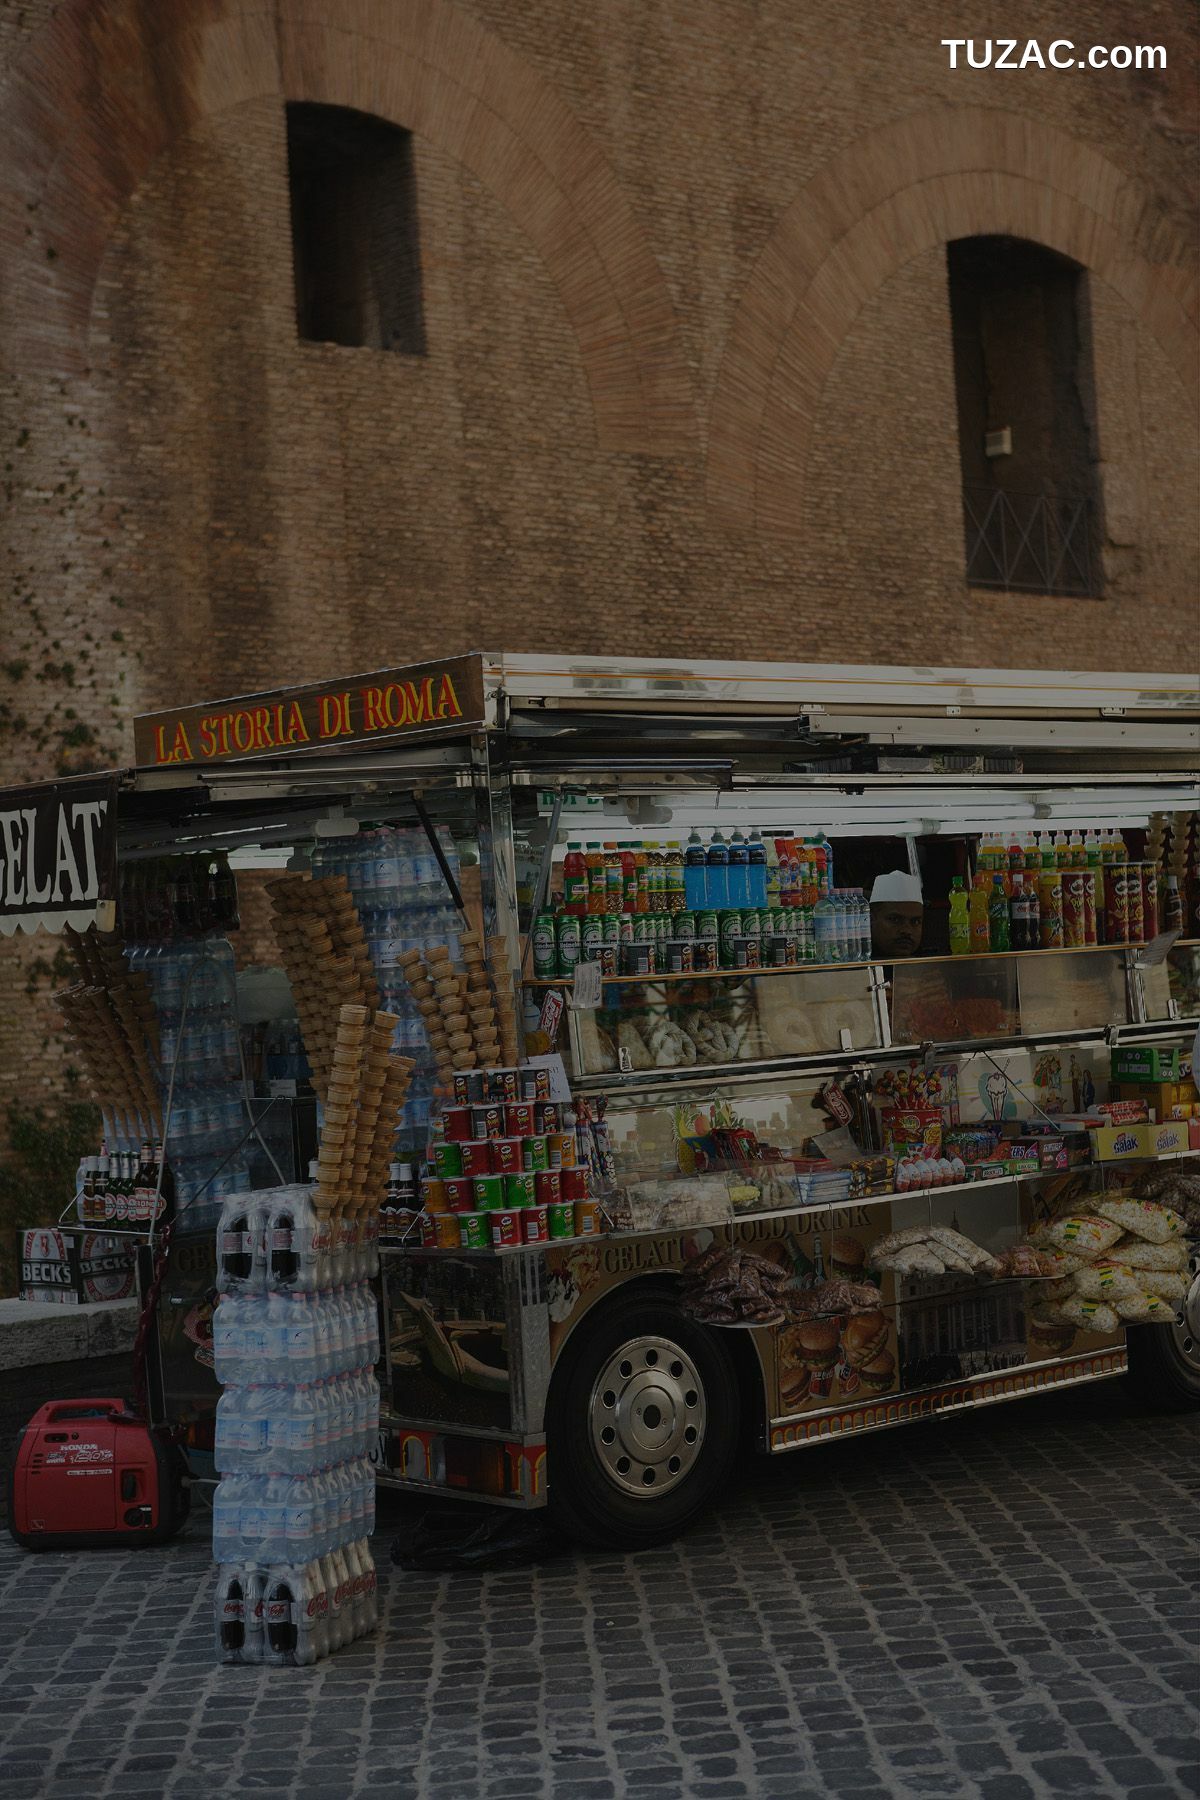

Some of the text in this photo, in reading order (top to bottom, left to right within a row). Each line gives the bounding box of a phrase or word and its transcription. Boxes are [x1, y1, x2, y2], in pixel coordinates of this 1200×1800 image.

[154, 673, 463, 765] LA STORIA DI ROMA
[0, 800, 108, 905] ELAT
[1113, 1136, 1139, 1154] Galak
[1156, 1133, 1179, 1151] Galak
[723, 1205, 871, 1246] COLD DRINK
[604, 1235, 686, 1274] GELATI
[22, 1261, 72, 1283] BECK'S
[60, 1443, 98, 1451] HONDA
